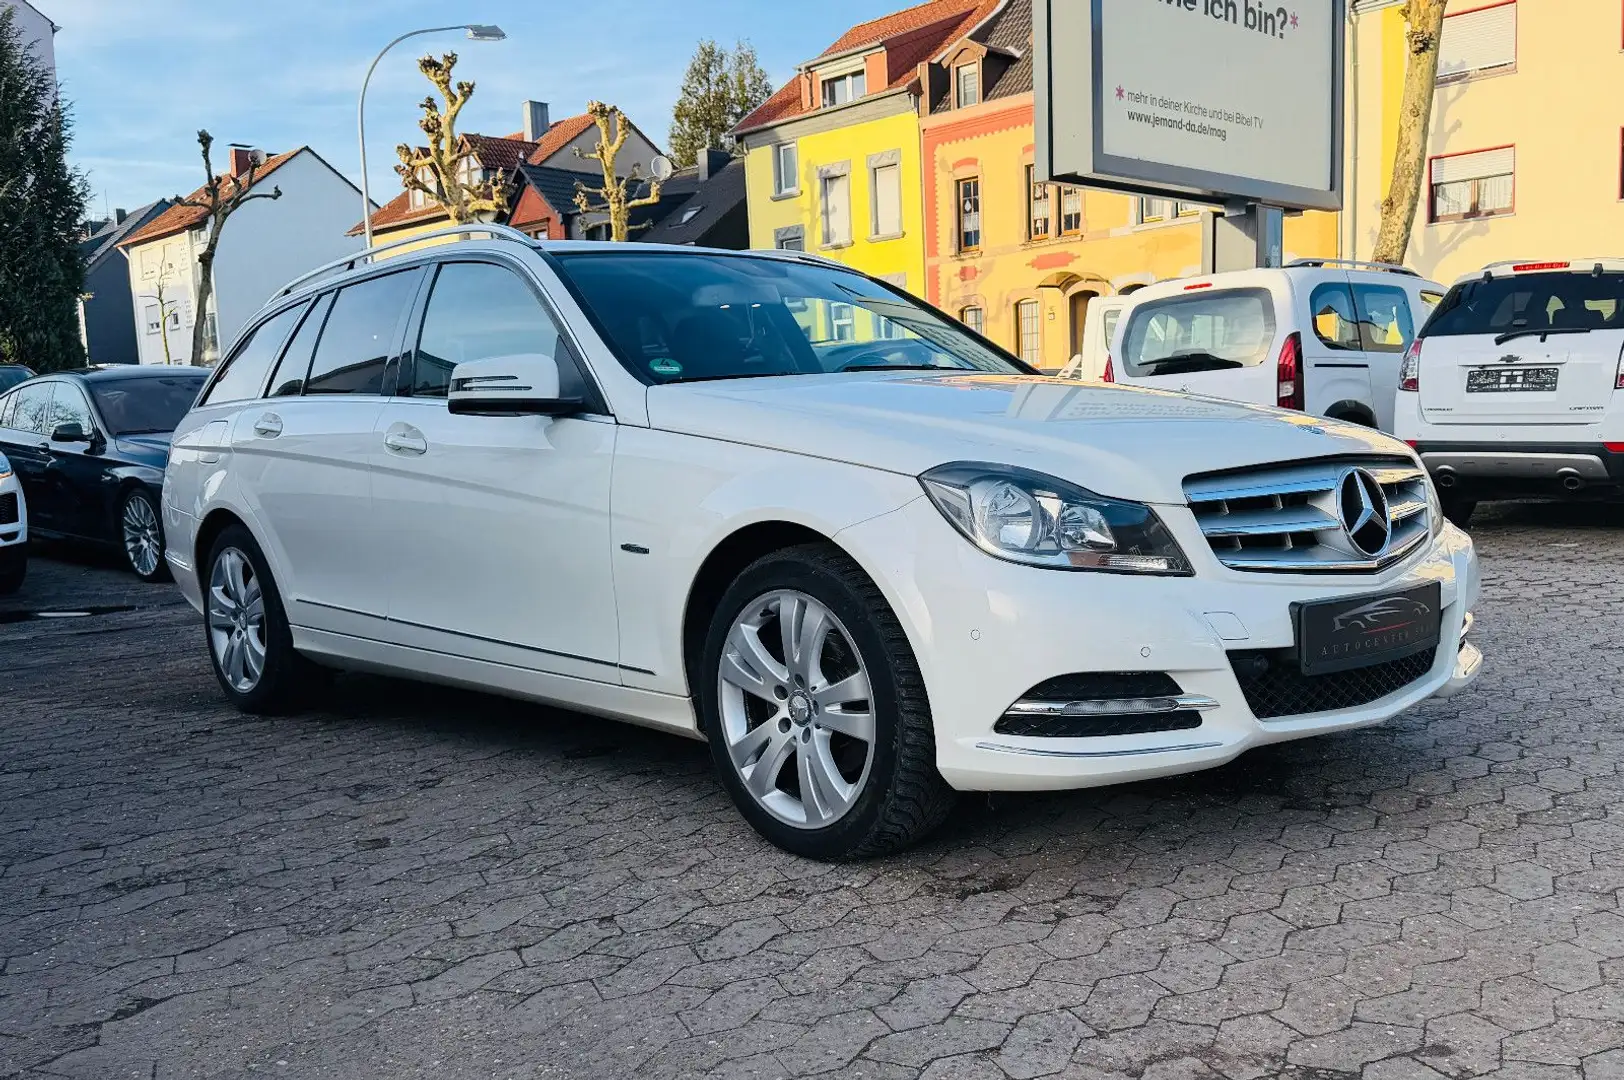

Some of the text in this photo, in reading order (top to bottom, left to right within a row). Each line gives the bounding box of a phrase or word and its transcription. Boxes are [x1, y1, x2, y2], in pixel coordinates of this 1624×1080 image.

[1127, 91, 1148, 104] mehr
[1149, 93, 1157, 107] in
[1158, 96, 1182, 112] deiner
[1183, 100, 1207, 117] Kirche
[1208, 108, 1222, 120] und
[1223, 108, 1235, 123] bei
[1235, 112, 1252, 127] Bibel
[1253, 116, 1264, 129] TV
[1127, 110, 1226, 141] www.jemand-da.de/mag
